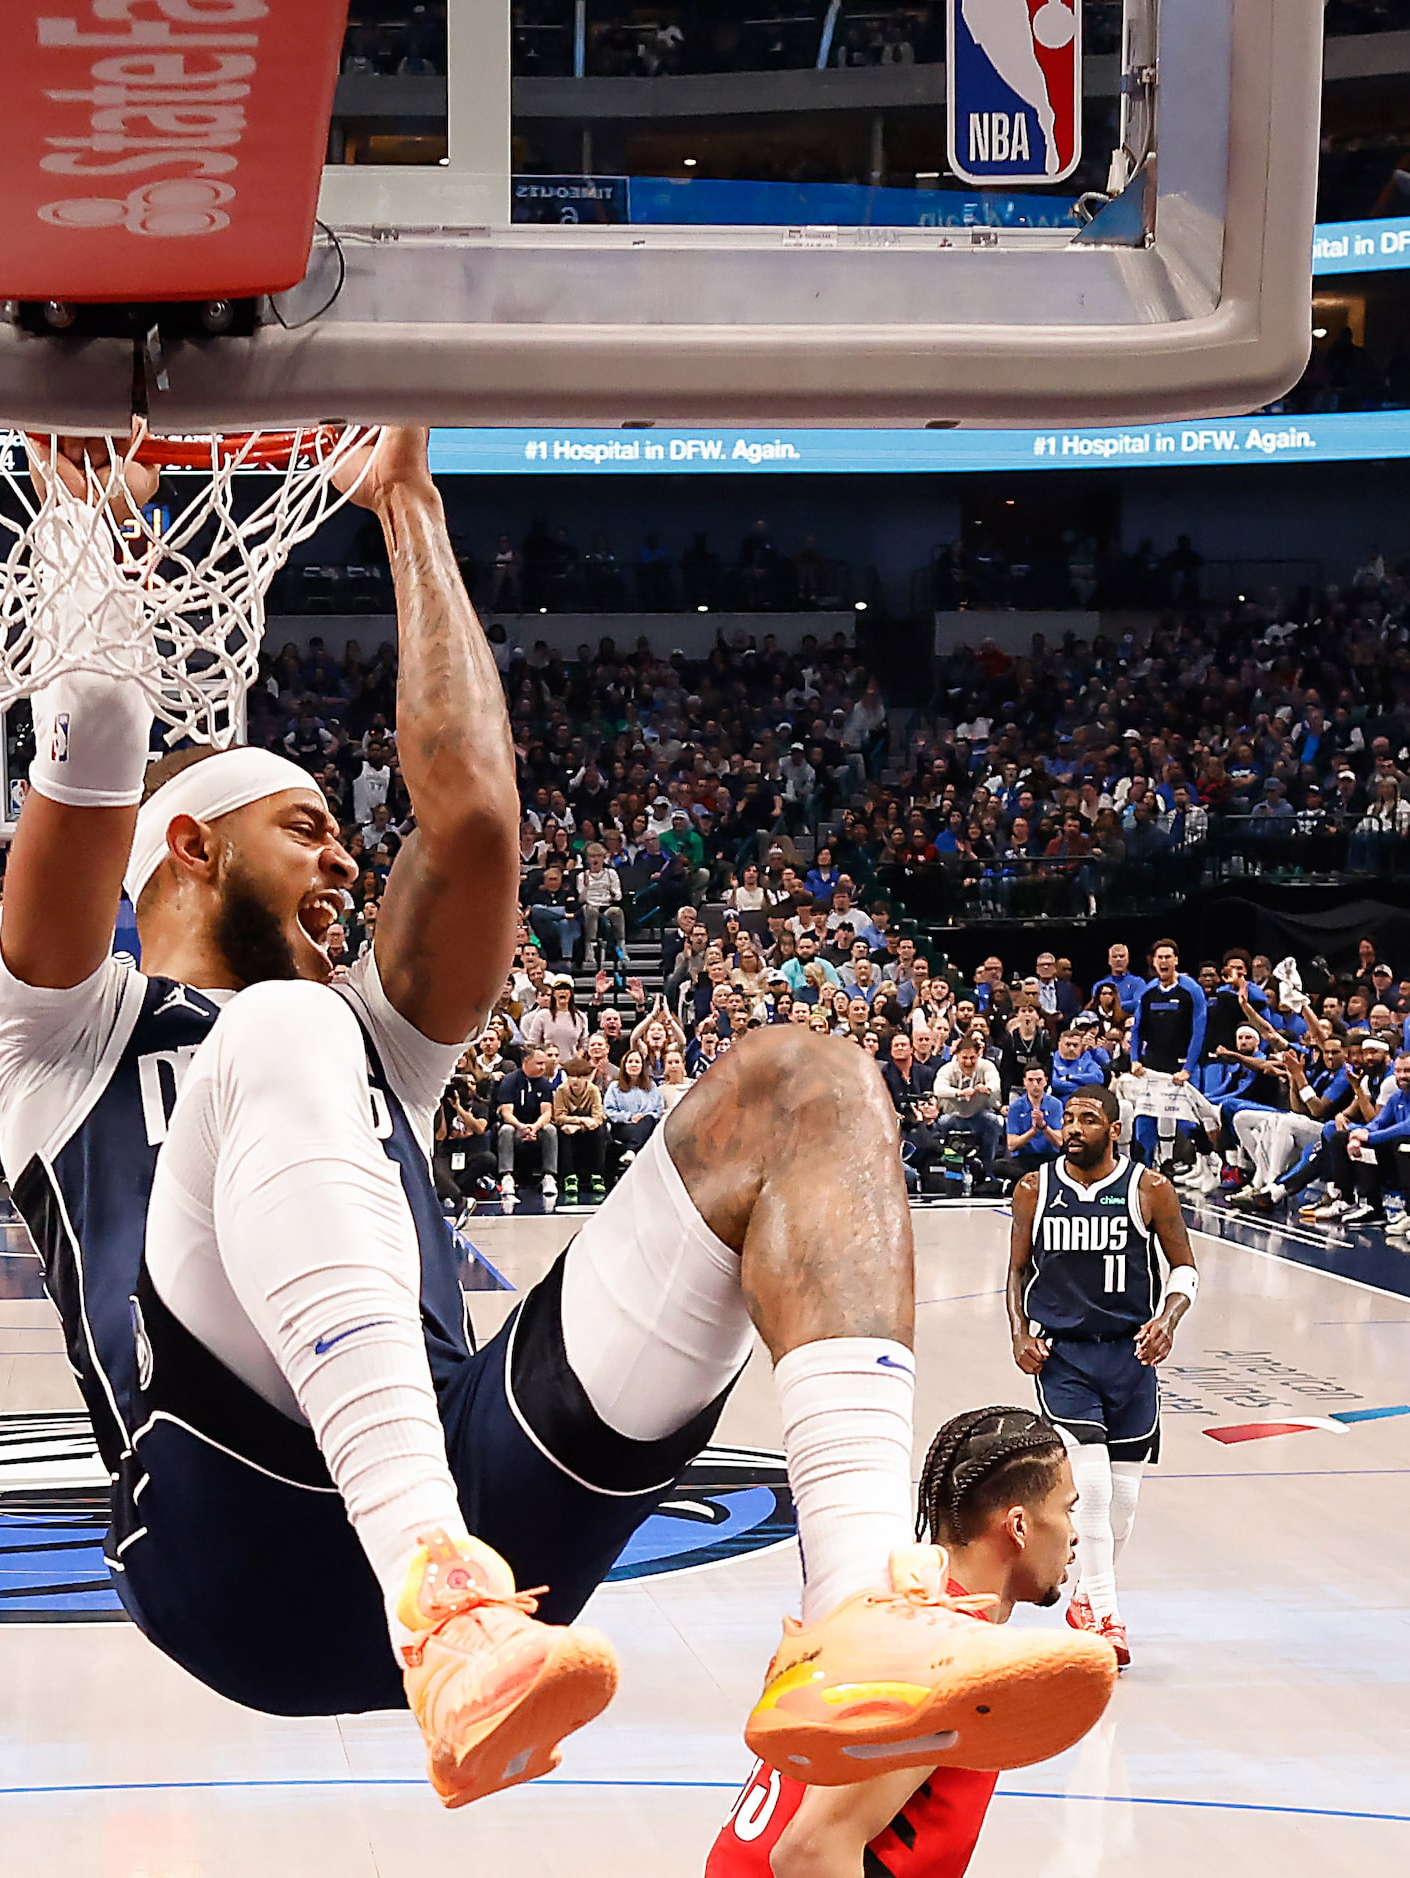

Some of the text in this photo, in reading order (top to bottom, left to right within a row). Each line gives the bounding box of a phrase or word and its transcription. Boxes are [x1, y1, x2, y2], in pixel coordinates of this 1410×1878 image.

[969, 112, 1030, 162] NBA
[1312, 235, 1349, 259] ital
[1354, 235, 1374, 255] in
[525, 439, 801, 464] #1 Hospital in DFW. Again.
[1033, 428, 1316, 458] #1 Hospital in DFW. Again.
[1100, 1195, 1126, 1205] chime
[1043, 1216, 1128, 1251] MAVS
[1103, 1254, 1126, 1293] 11
[1203, 1350, 1365, 1401] American
